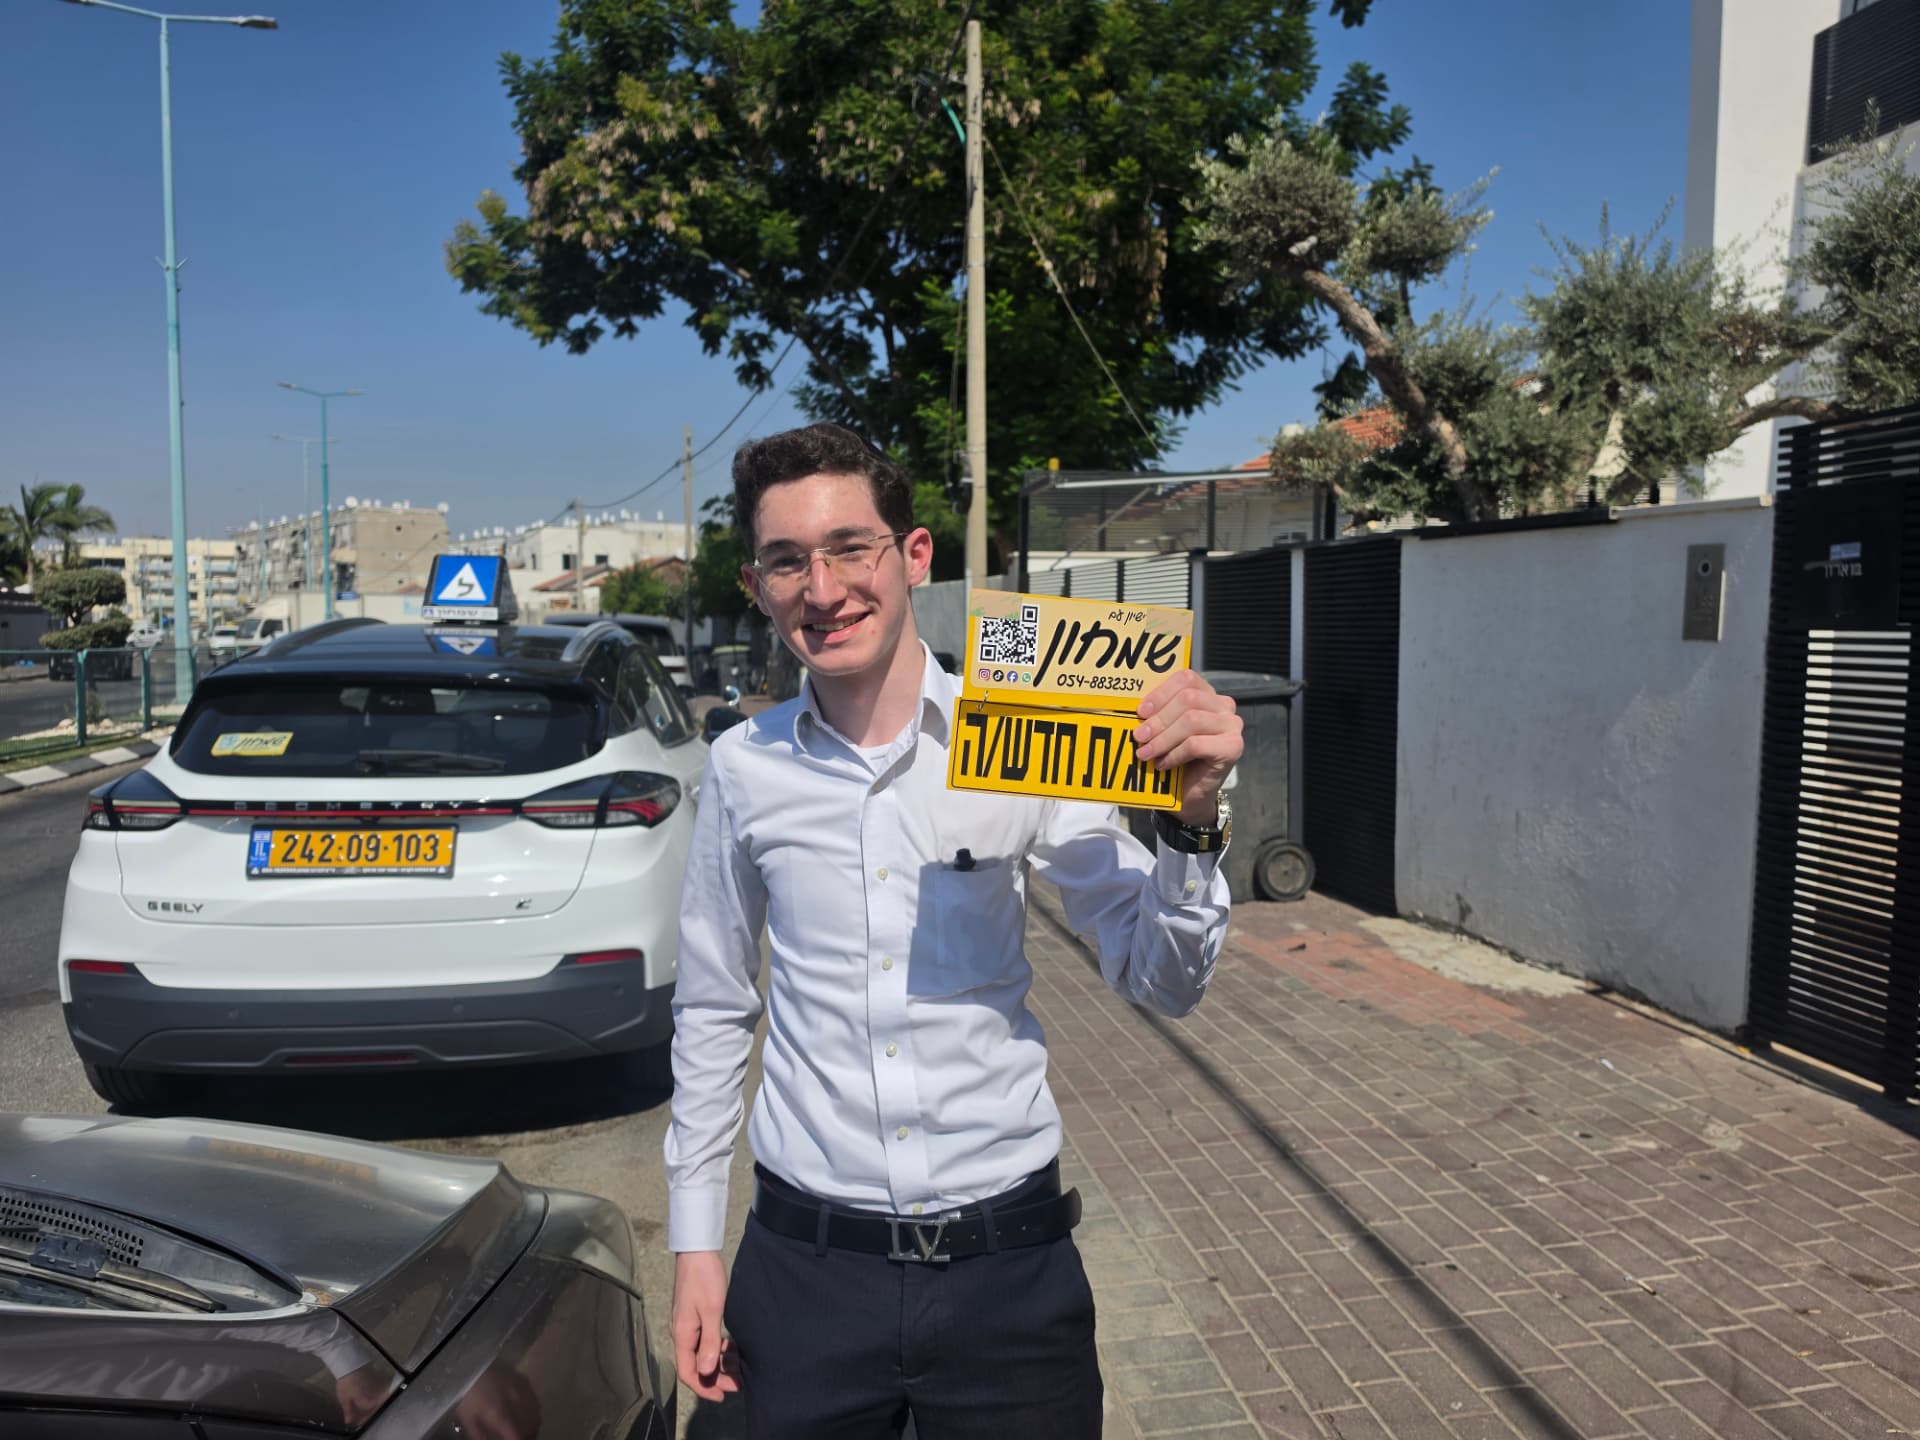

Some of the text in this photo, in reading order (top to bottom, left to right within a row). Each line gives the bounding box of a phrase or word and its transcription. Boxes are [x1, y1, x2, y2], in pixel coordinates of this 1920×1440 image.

[457, 577, 475, 598] ל
[1033, 619, 1182, 688] שמחון
[1057, 673, 1144, 692] 054-8832334
[961, 713, 1078, 786] חדש/ה
[147, 900, 204, 913] GEELY
